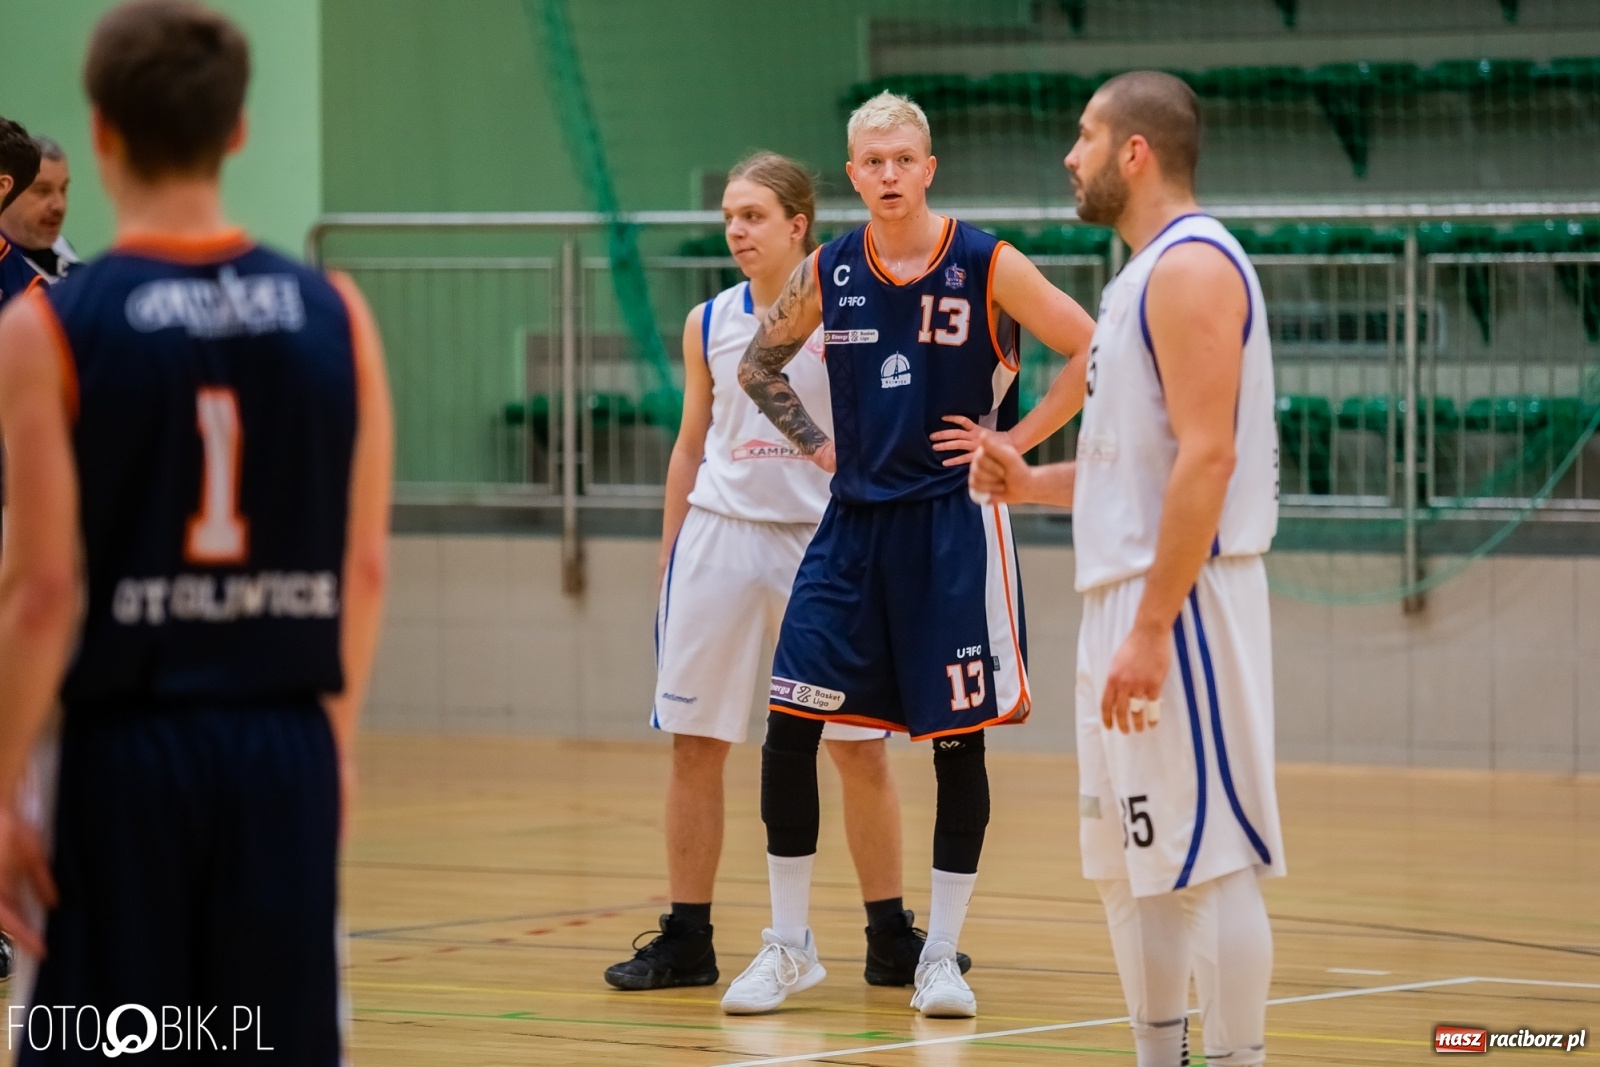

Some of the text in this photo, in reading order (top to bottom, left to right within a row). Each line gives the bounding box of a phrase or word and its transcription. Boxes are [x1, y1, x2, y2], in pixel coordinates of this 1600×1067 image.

[833, 264, 851, 287] C
[918, 294, 971, 347] 13
[183, 386, 248, 563] 1
[812, 698, 829, 707] Liga
[814, 690, 841, 702] Basket
[946, 659, 985, 711] 13
